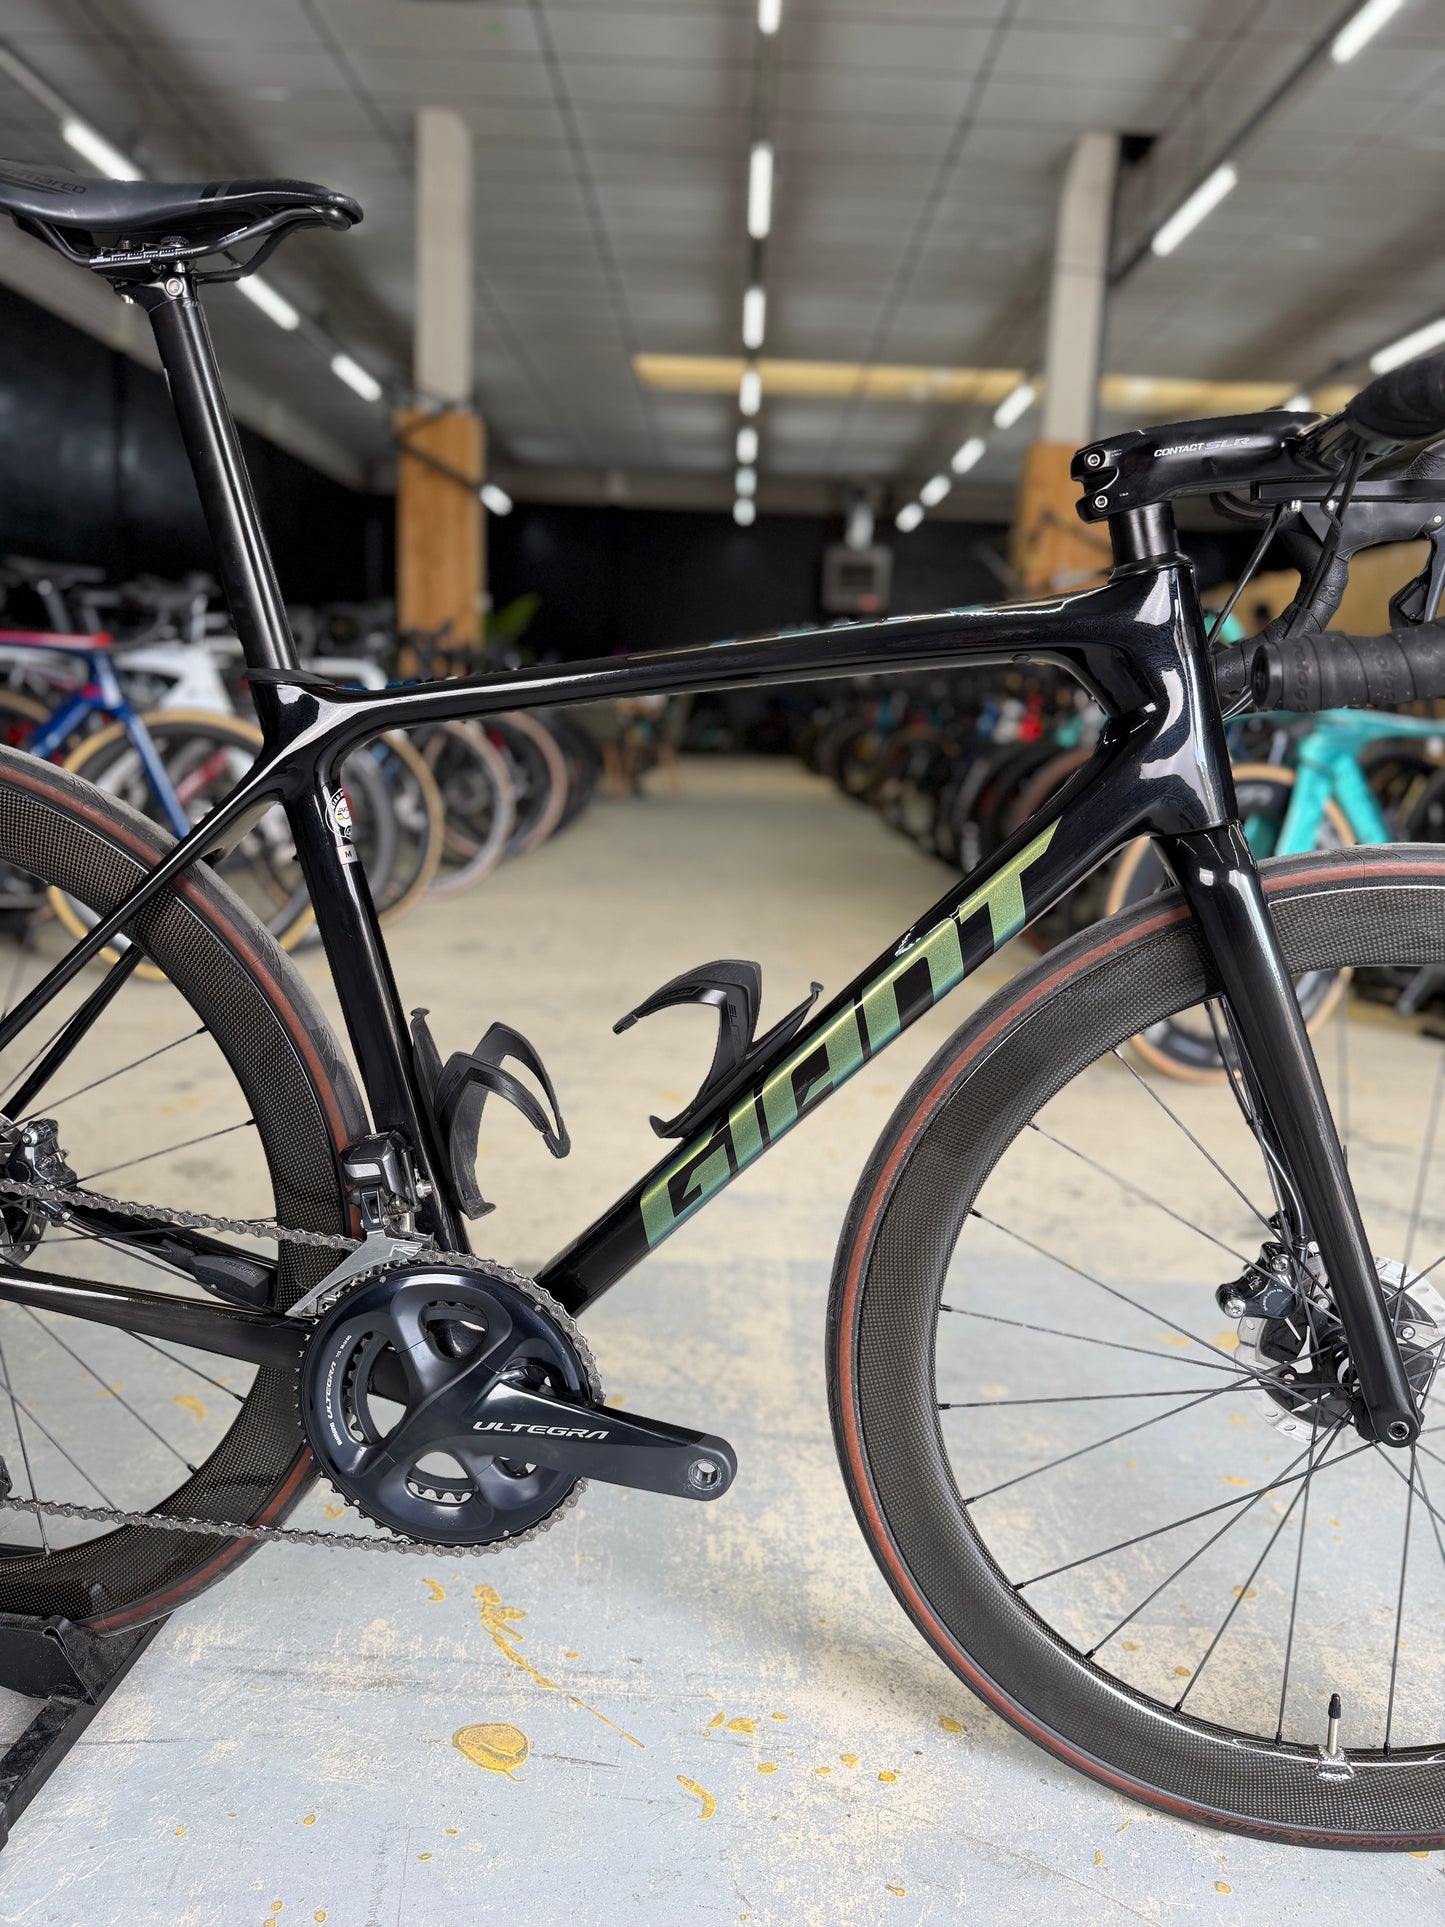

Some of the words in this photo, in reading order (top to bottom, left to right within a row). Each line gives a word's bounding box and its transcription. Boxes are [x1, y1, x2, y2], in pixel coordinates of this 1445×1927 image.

[1154, 442, 1205, 457] CONTACT
[1205, 437, 1249, 450] SLR
[344, 850, 352, 858] M
[640, 815, 1063, 1249] GIANT
[325, 1361, 337, 1420] ULTEGRA
[473, 1421, 609, 1440] ULTEGRA
